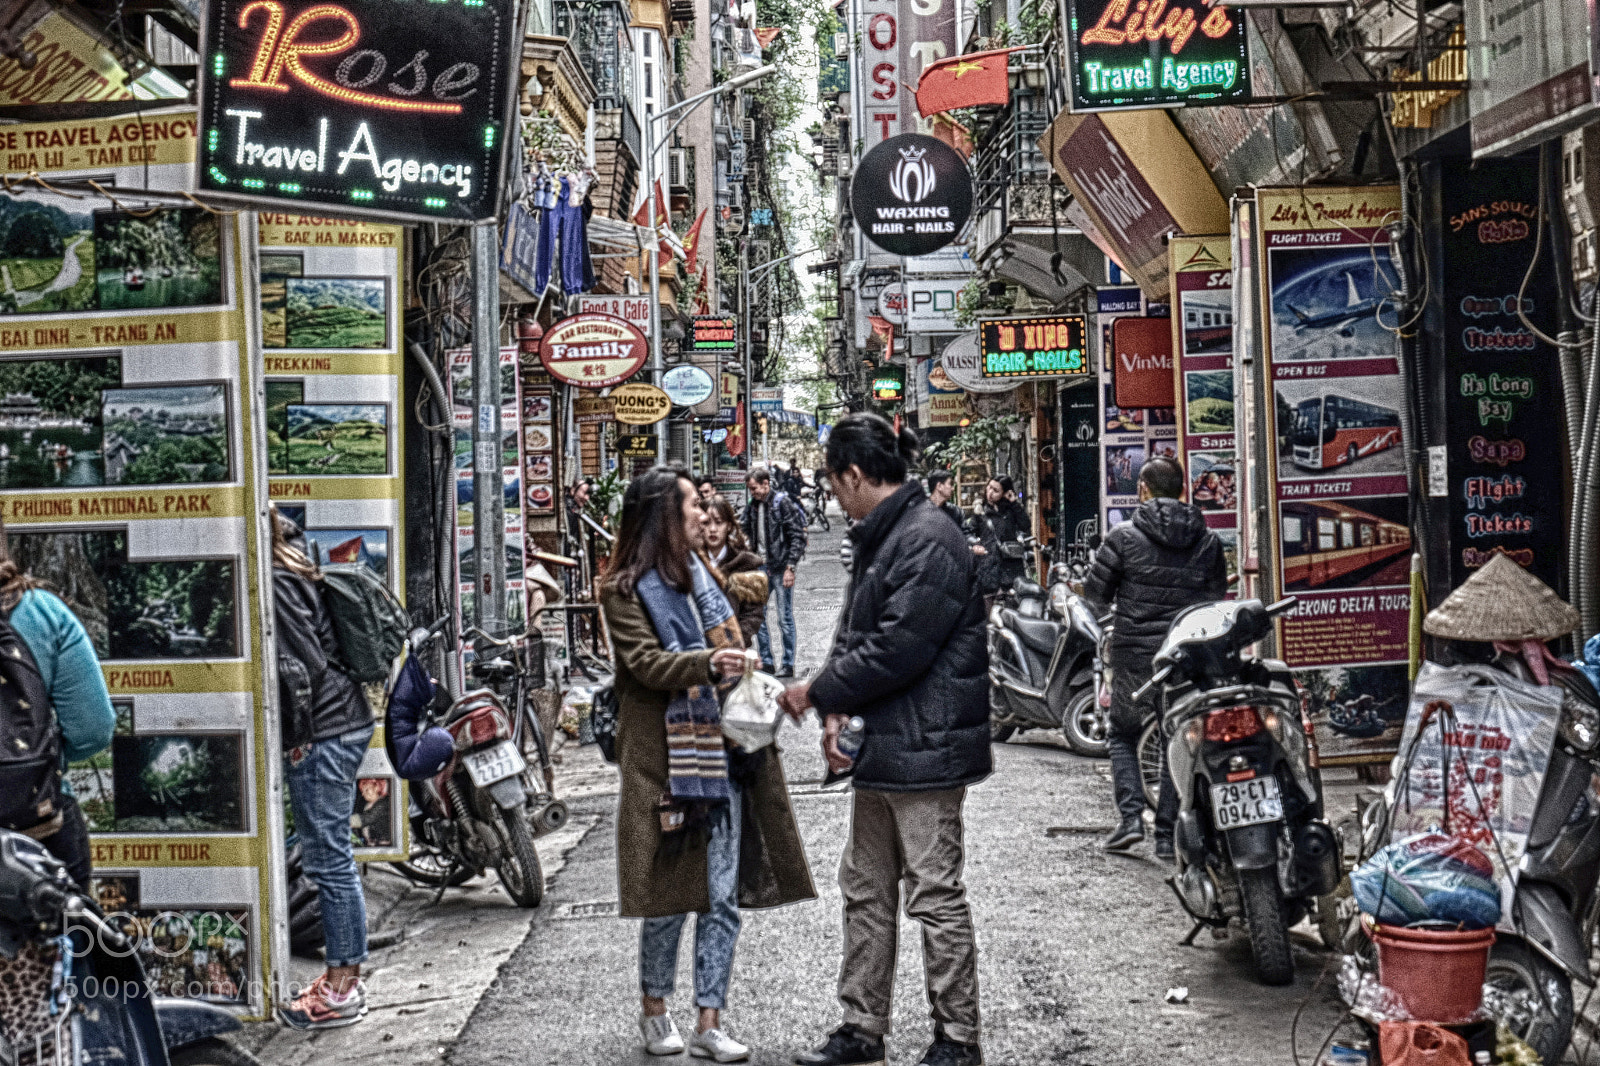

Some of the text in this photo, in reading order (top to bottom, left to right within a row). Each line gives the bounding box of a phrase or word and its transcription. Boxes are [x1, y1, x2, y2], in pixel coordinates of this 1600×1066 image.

[229, 0, 480, 114] Rose
[1085, 57, 1236, 91] Travel Agency
[23, 126, 101, 148] TRAVEL
[107, 120, 197, 143] AGENCY
[8, 153, 38, 170] HOA
[87, 148, 123, 166] TAM
[225, 108, 472, 198] Travel Agency
[876, 207, 949, 220] WAXING
[1313, 202, 1354, 220] Travel
[1450, 204, 1489, 232] SANS
[872, 223, 904, 234] HAIR
[915, 221, 955, 233] NAILS
[315, 231, 333, 244] HA
[338, 231, 396, 245] MARKET
[1271, 232, 1342, 244] FLIGHT TICKETS
[582, 301, 607, 313] Food
[624, 299, 650, 320] Café
[1, 329, 29, 347] BAI
[34, 328, 70, 346] DINH
[91, 323, 149, 343] TRANG
[153, 323, 177, 341] AN
[551, 342, 634, 359] Family
[264, 357, 331, 370] TREKKING
[1276, 365, 1327, 377] OPEN BUS
[1462, 375, 1532, 396] Ha Long
[1480, 399, 1511, 419] Bay
[631, 437, 648, 448] 27
[1469, 437, 1524, 464] Sapa
[1281, 482, 1352, 496] TRAIN TICKETS
[1466, 478, 1523, 501] Flight
[12, 499, 72, 517] PHUONG
[79, 496, 158, 515] NATIONAL
[163, 494, 211, 513] PARK
[1466, 515, 1532, 535] Tickets
[1340, 596, 1375, 613] DELTA
[109, 670, 174, 688] PAGODA
[167, 843, 211, 861] TOUR
